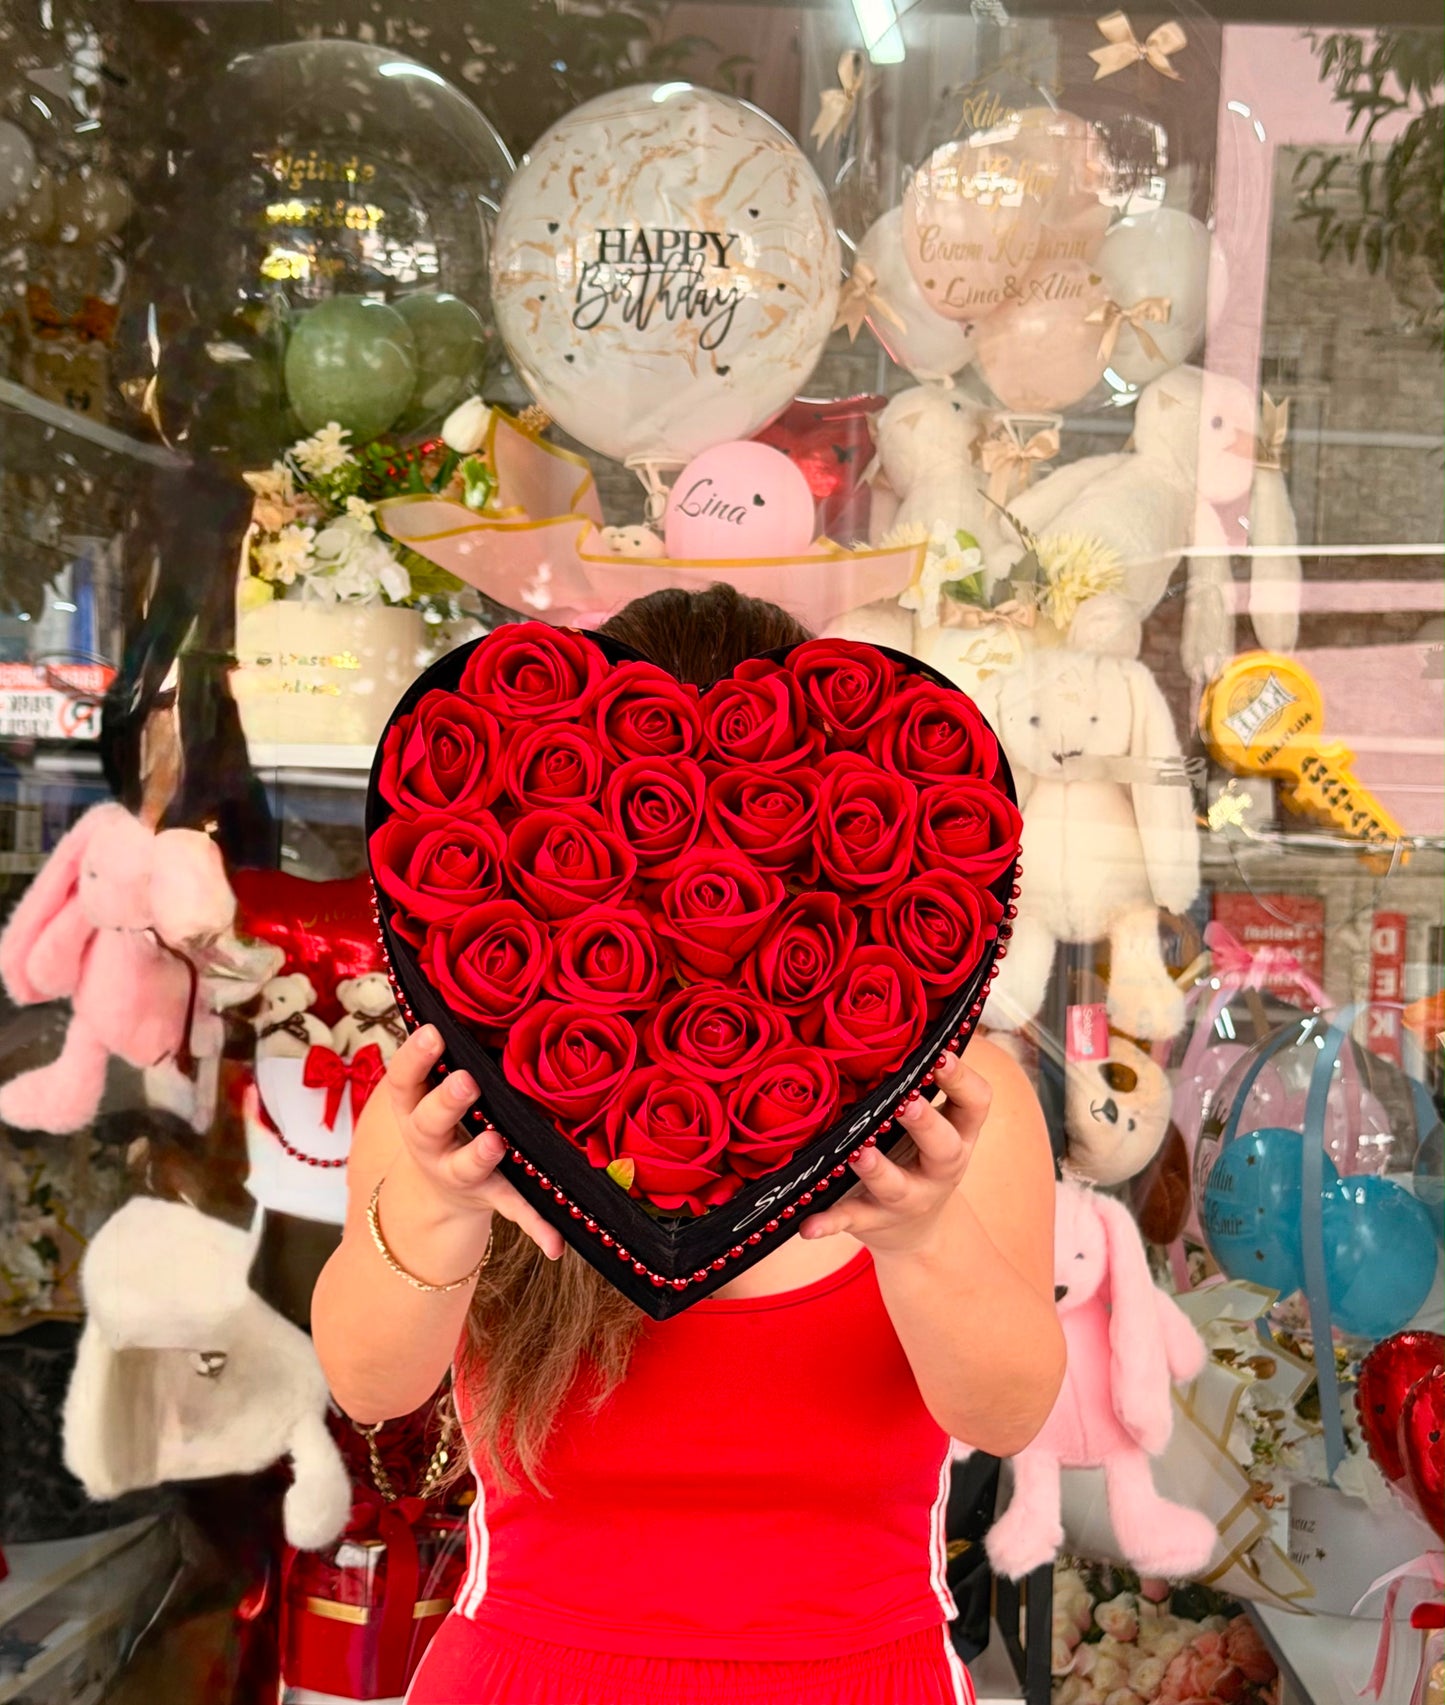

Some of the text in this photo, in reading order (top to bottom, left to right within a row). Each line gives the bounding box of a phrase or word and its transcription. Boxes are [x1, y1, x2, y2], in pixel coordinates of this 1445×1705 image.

[595, 227, 740, 269] HAPPY
[572, 251, 744, 351] Birthday
[674, 478, 748, 525] Lina
[732, 1154, 825, 1232] Seni
